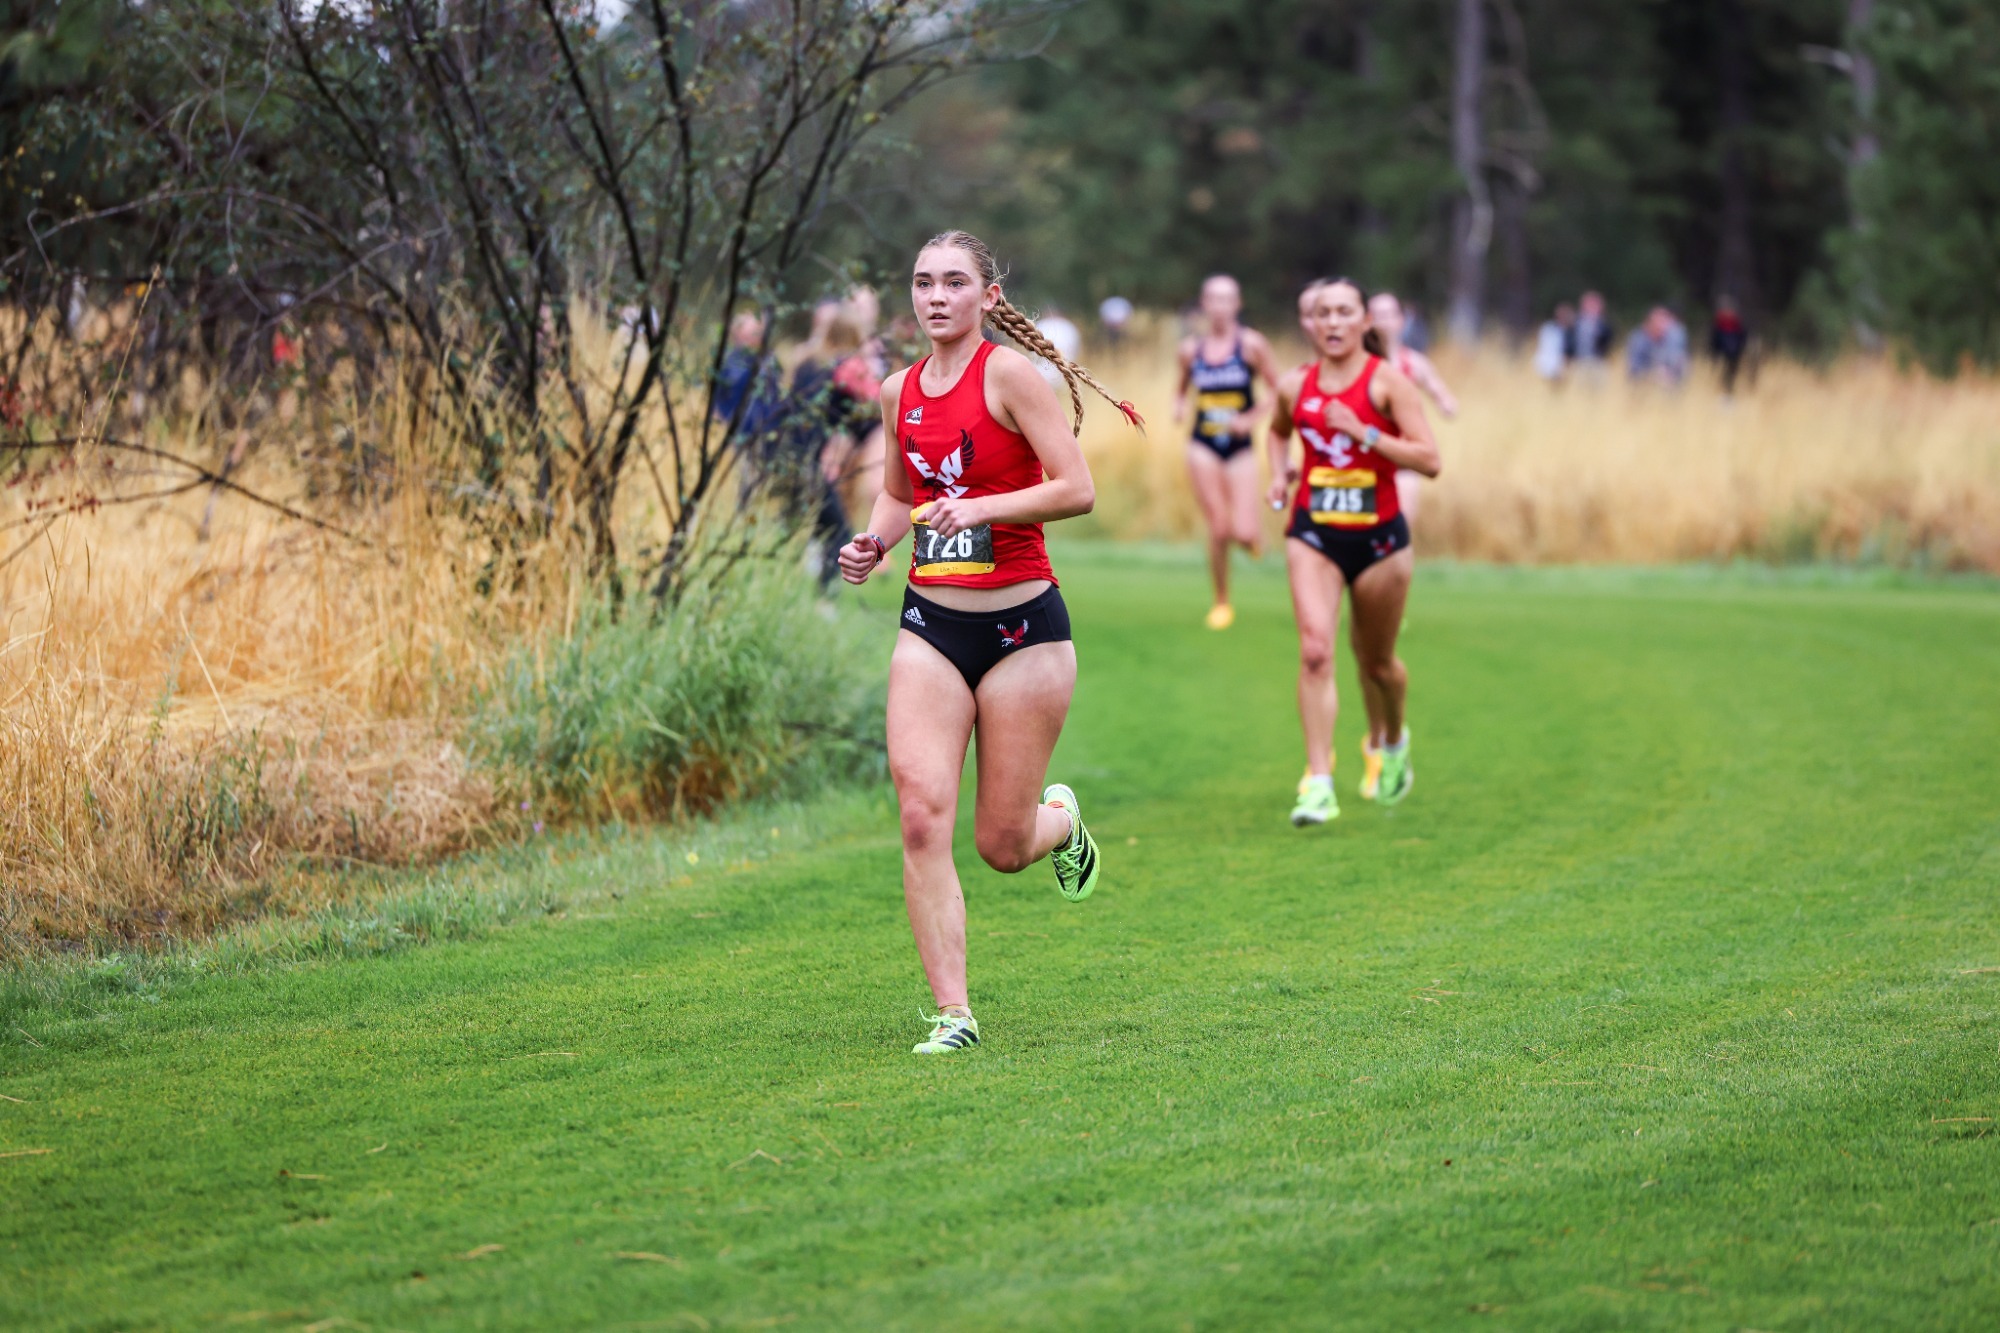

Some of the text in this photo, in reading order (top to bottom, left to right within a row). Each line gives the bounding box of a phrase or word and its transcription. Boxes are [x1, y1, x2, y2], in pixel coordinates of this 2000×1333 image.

[1322, 487, 1363, 513] 715
[926, 528, 973, 559] 726
[904, 612, 925, 627] adidas
